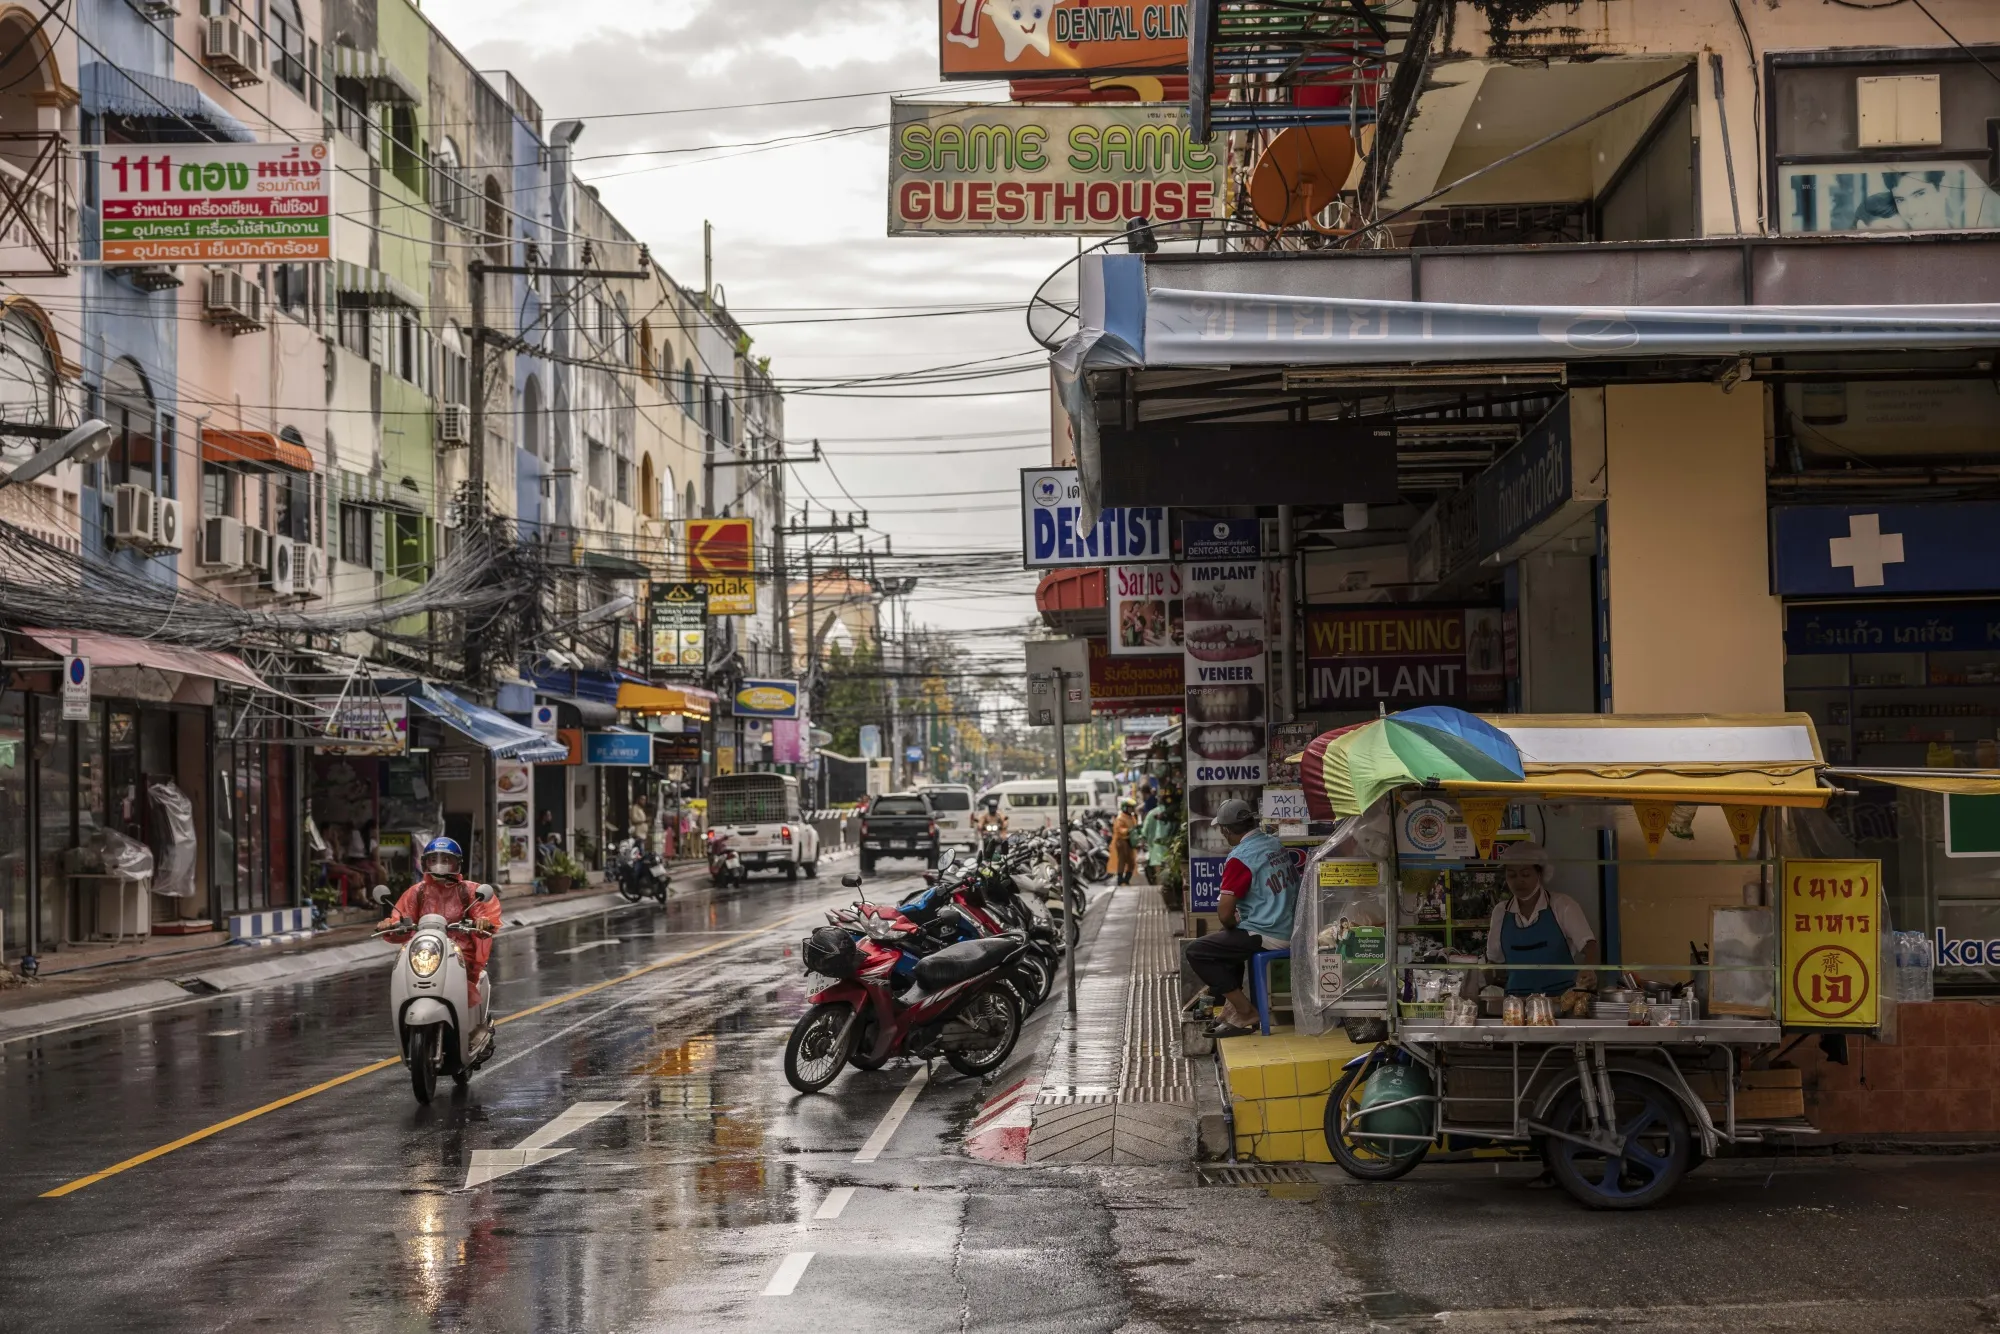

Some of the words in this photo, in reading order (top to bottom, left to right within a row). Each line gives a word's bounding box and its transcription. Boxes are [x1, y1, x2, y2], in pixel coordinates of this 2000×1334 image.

[1056, 7, 1139, 41] DENTAL
[1143, 4, 1188, 38] CLIN
[900, 123, 1050, 172] SAME
[1068, 123, 1218, 172] SAME
[112, 155, 171, 192] 111
[179, 162, 249, 192] ตอง
[132, 202, 183, 217] จำหน่าย
[900, 179, 1216, 223] GUESTHOUSE
[132, 222, 190, 239] อุปกรณ์
[133, 243, 200, 260] อุปกรณ์
[1034, 507, 1163, 559] DENTIST
[1188, 546, 1229, 555] DENTCARE
[1231, 545, 1256, 553] CLINIC
[1191, 565, 1257, 581] IMPLANT
[702, 577, 748, 595] odak
[1312, 619, 1461, 651] WHITENING
[1198, 666, 1253, 681] VENEER
[1313, 664, 1461, 699] IMPLANT
[1187, 687, 1218, 695] veneer
[1196, 765, 1260, 781] CROWNS
[1272, 796, 1296, 804] TAXI
[1195, 862, 1215, 877] TEL:
[1196, 882, 1220, 896] 091-
[1795, 914, 1870, 935] อาหาร
[1811, 974, 1852, 1003] เจ
